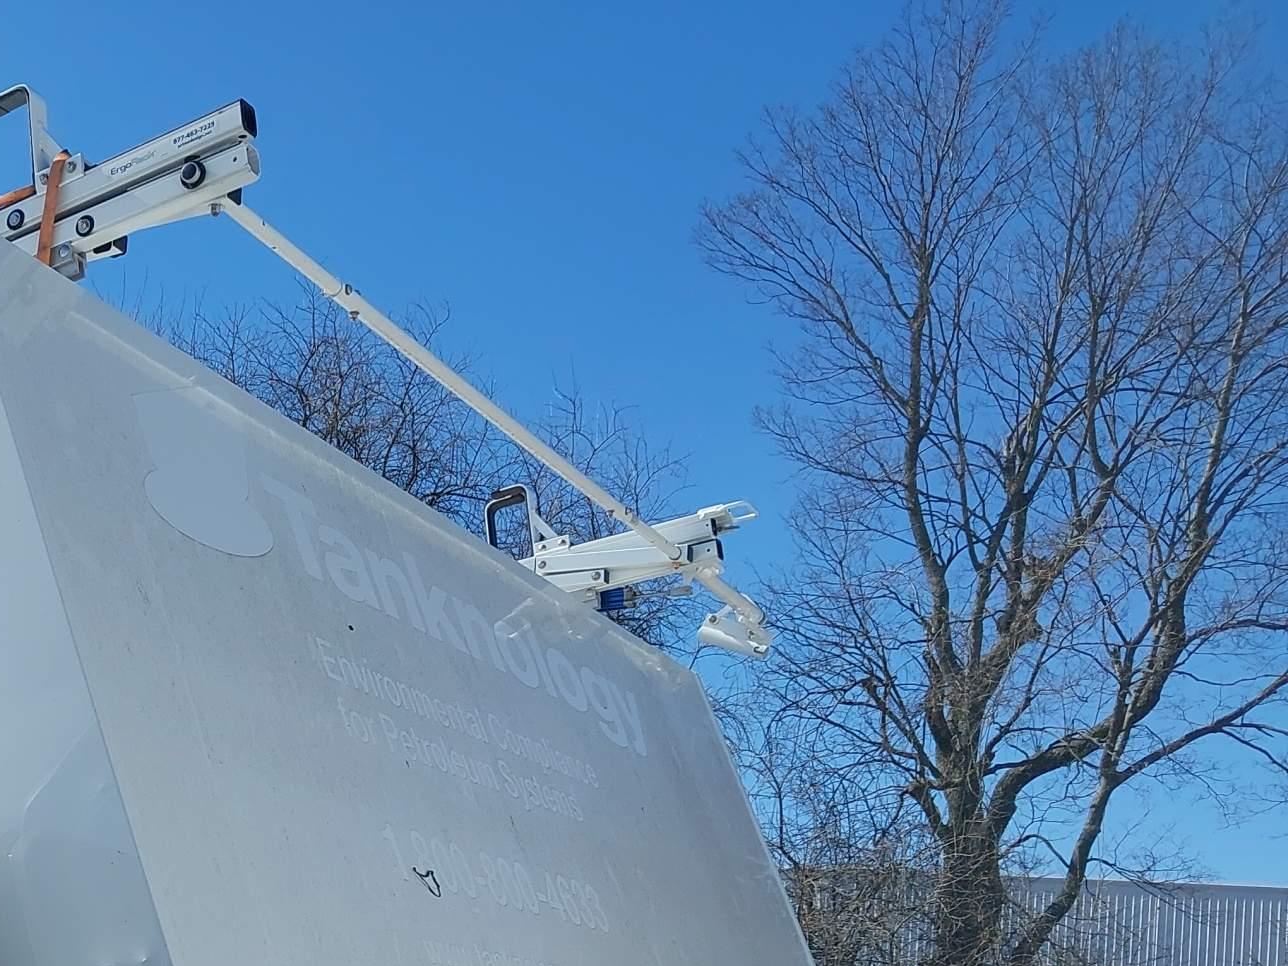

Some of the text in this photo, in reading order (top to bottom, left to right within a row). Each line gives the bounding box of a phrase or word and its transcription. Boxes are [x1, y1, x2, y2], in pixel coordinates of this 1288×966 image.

[260, 473, 649, 758] Tanknology
[314, 636, 601, 789] Environmental Compliance
[377, 711, 501, 791] Petroleum
[497, 759, 585, 823] Systems
